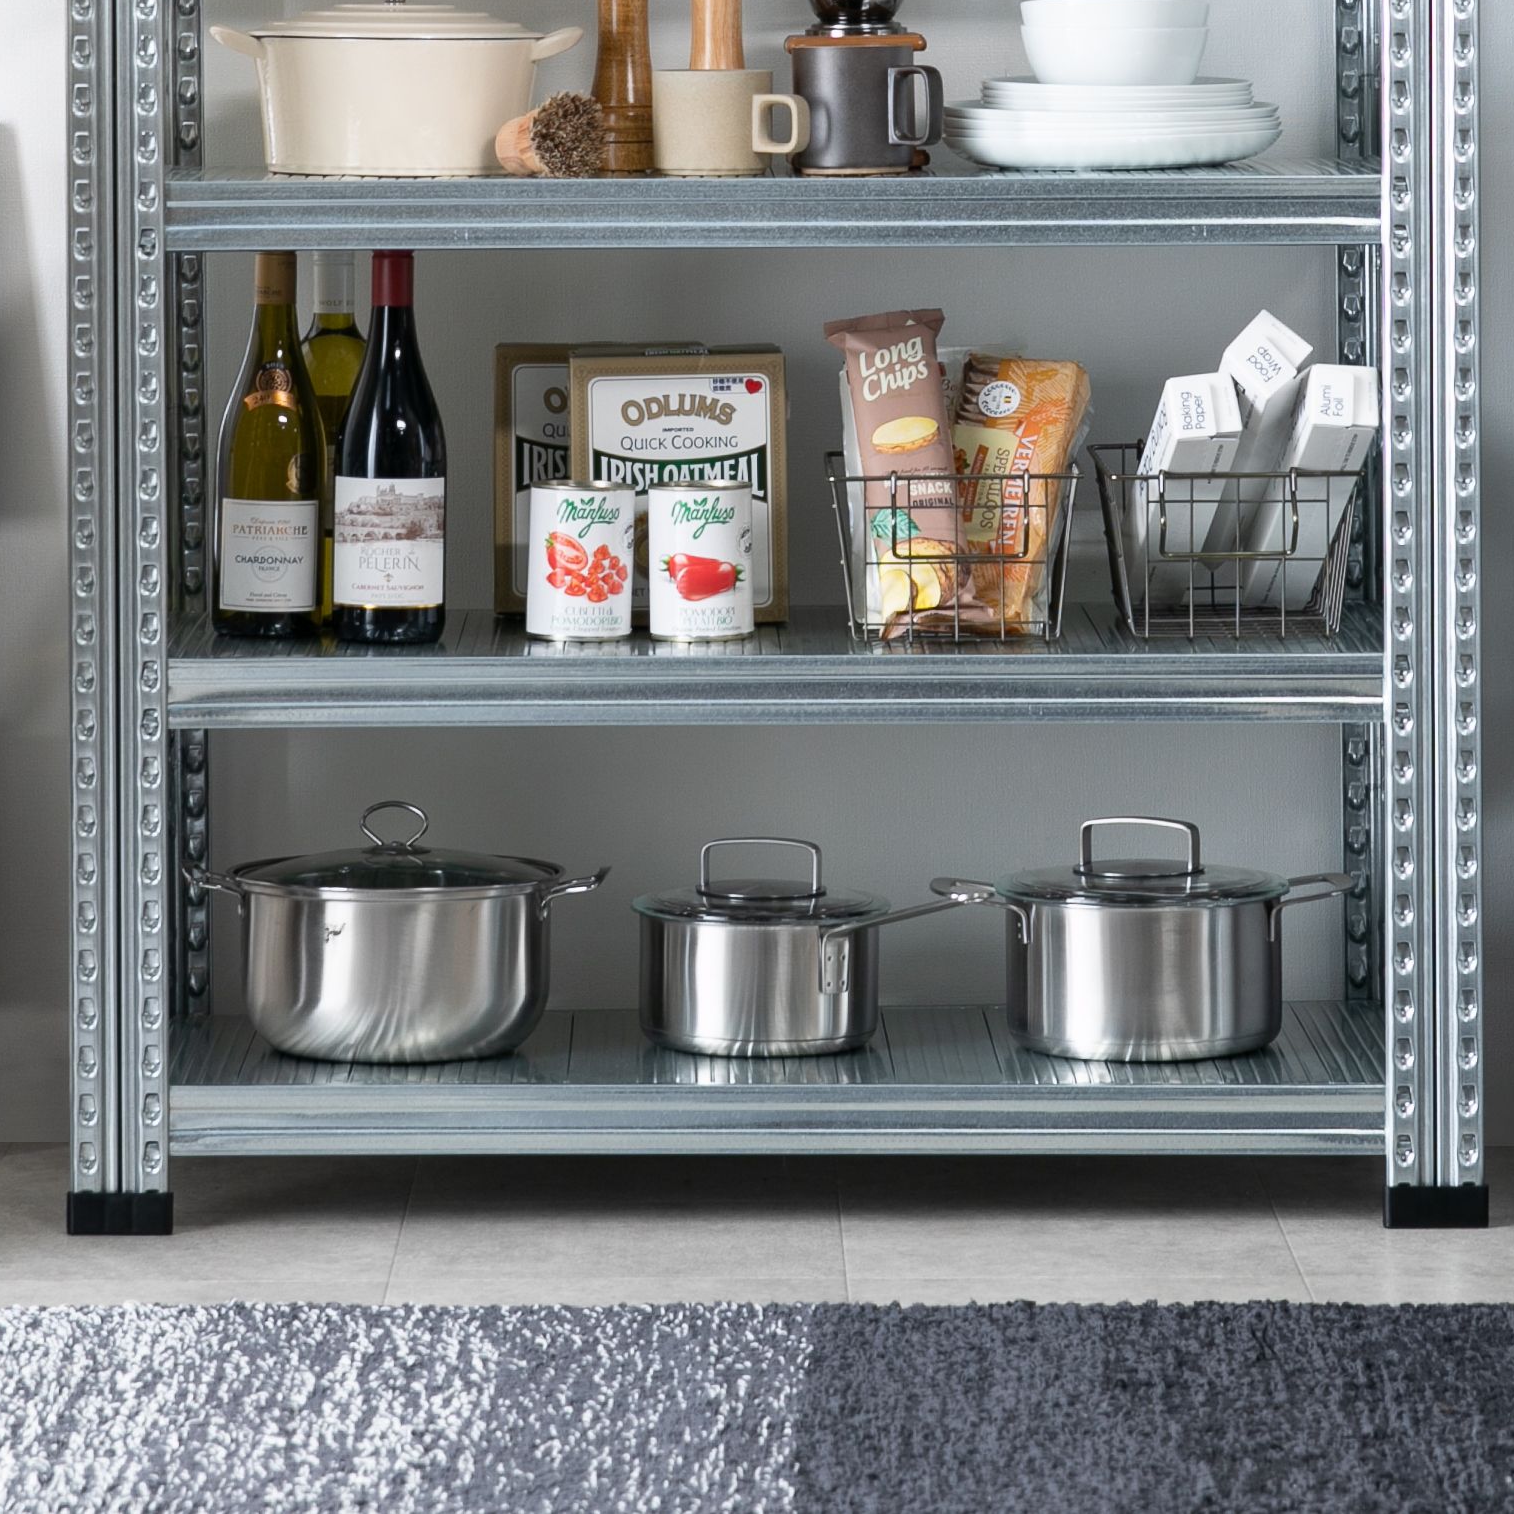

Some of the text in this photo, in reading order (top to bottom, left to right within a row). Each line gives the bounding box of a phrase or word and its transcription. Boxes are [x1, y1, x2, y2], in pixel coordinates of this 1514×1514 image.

[858, 336, 924, 376] Long
[1245, 354, 1272, 384] Food
[1256, 344, 1284, 376] Wrap
[862, 357, 929, 402] Chips
[620, 393, 738, 427] ODLUMS
[1182, 391, 1193, 431] Baking
[1194, 394, 1206, 430] Paper
[1320, 384, 1333, 417] Alumi
[1332, 397, 1344, 418] Foil
[620, 434, 739, 451] QUICK COOKING
[600, 453, 765, 497] IRISH OATMEAL
[909, 481, 953, 496] SNACK
[980, 447, 1011, 530] SPEULOOS
[556, 497, 620, 539] Manfuso
[671, 497, 735, 539] Manfuso
[912, 497, 955, 507] ORIGINAL
[232, 524, 308, 536] PATRIARCHE
[234, 554, 304, 565] CHARDONNAY
